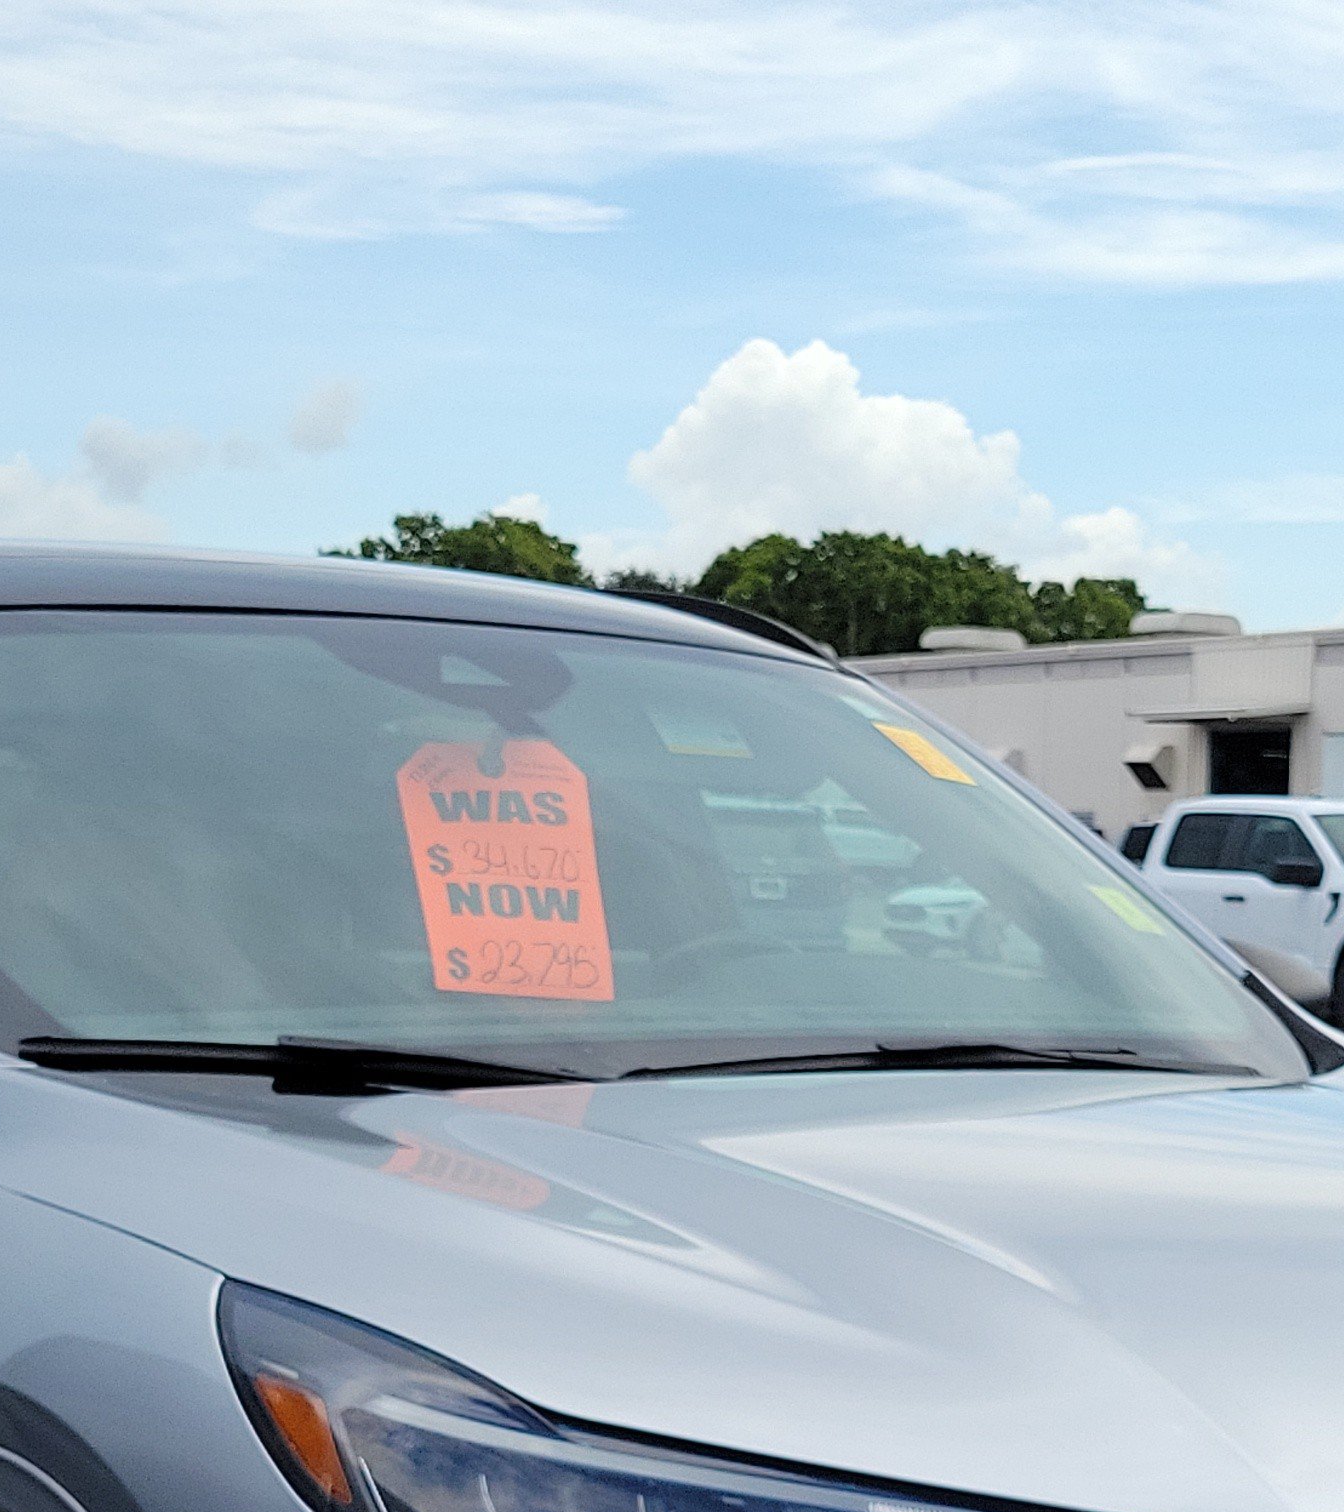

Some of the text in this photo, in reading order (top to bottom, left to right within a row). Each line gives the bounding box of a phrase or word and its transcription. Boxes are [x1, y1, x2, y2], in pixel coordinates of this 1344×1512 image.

[428, 789, 568, 827] WAS
[427, 844, 454, 876] $
[446, 882, 580, 923] NOW
[447, 946, 471, 980] $
